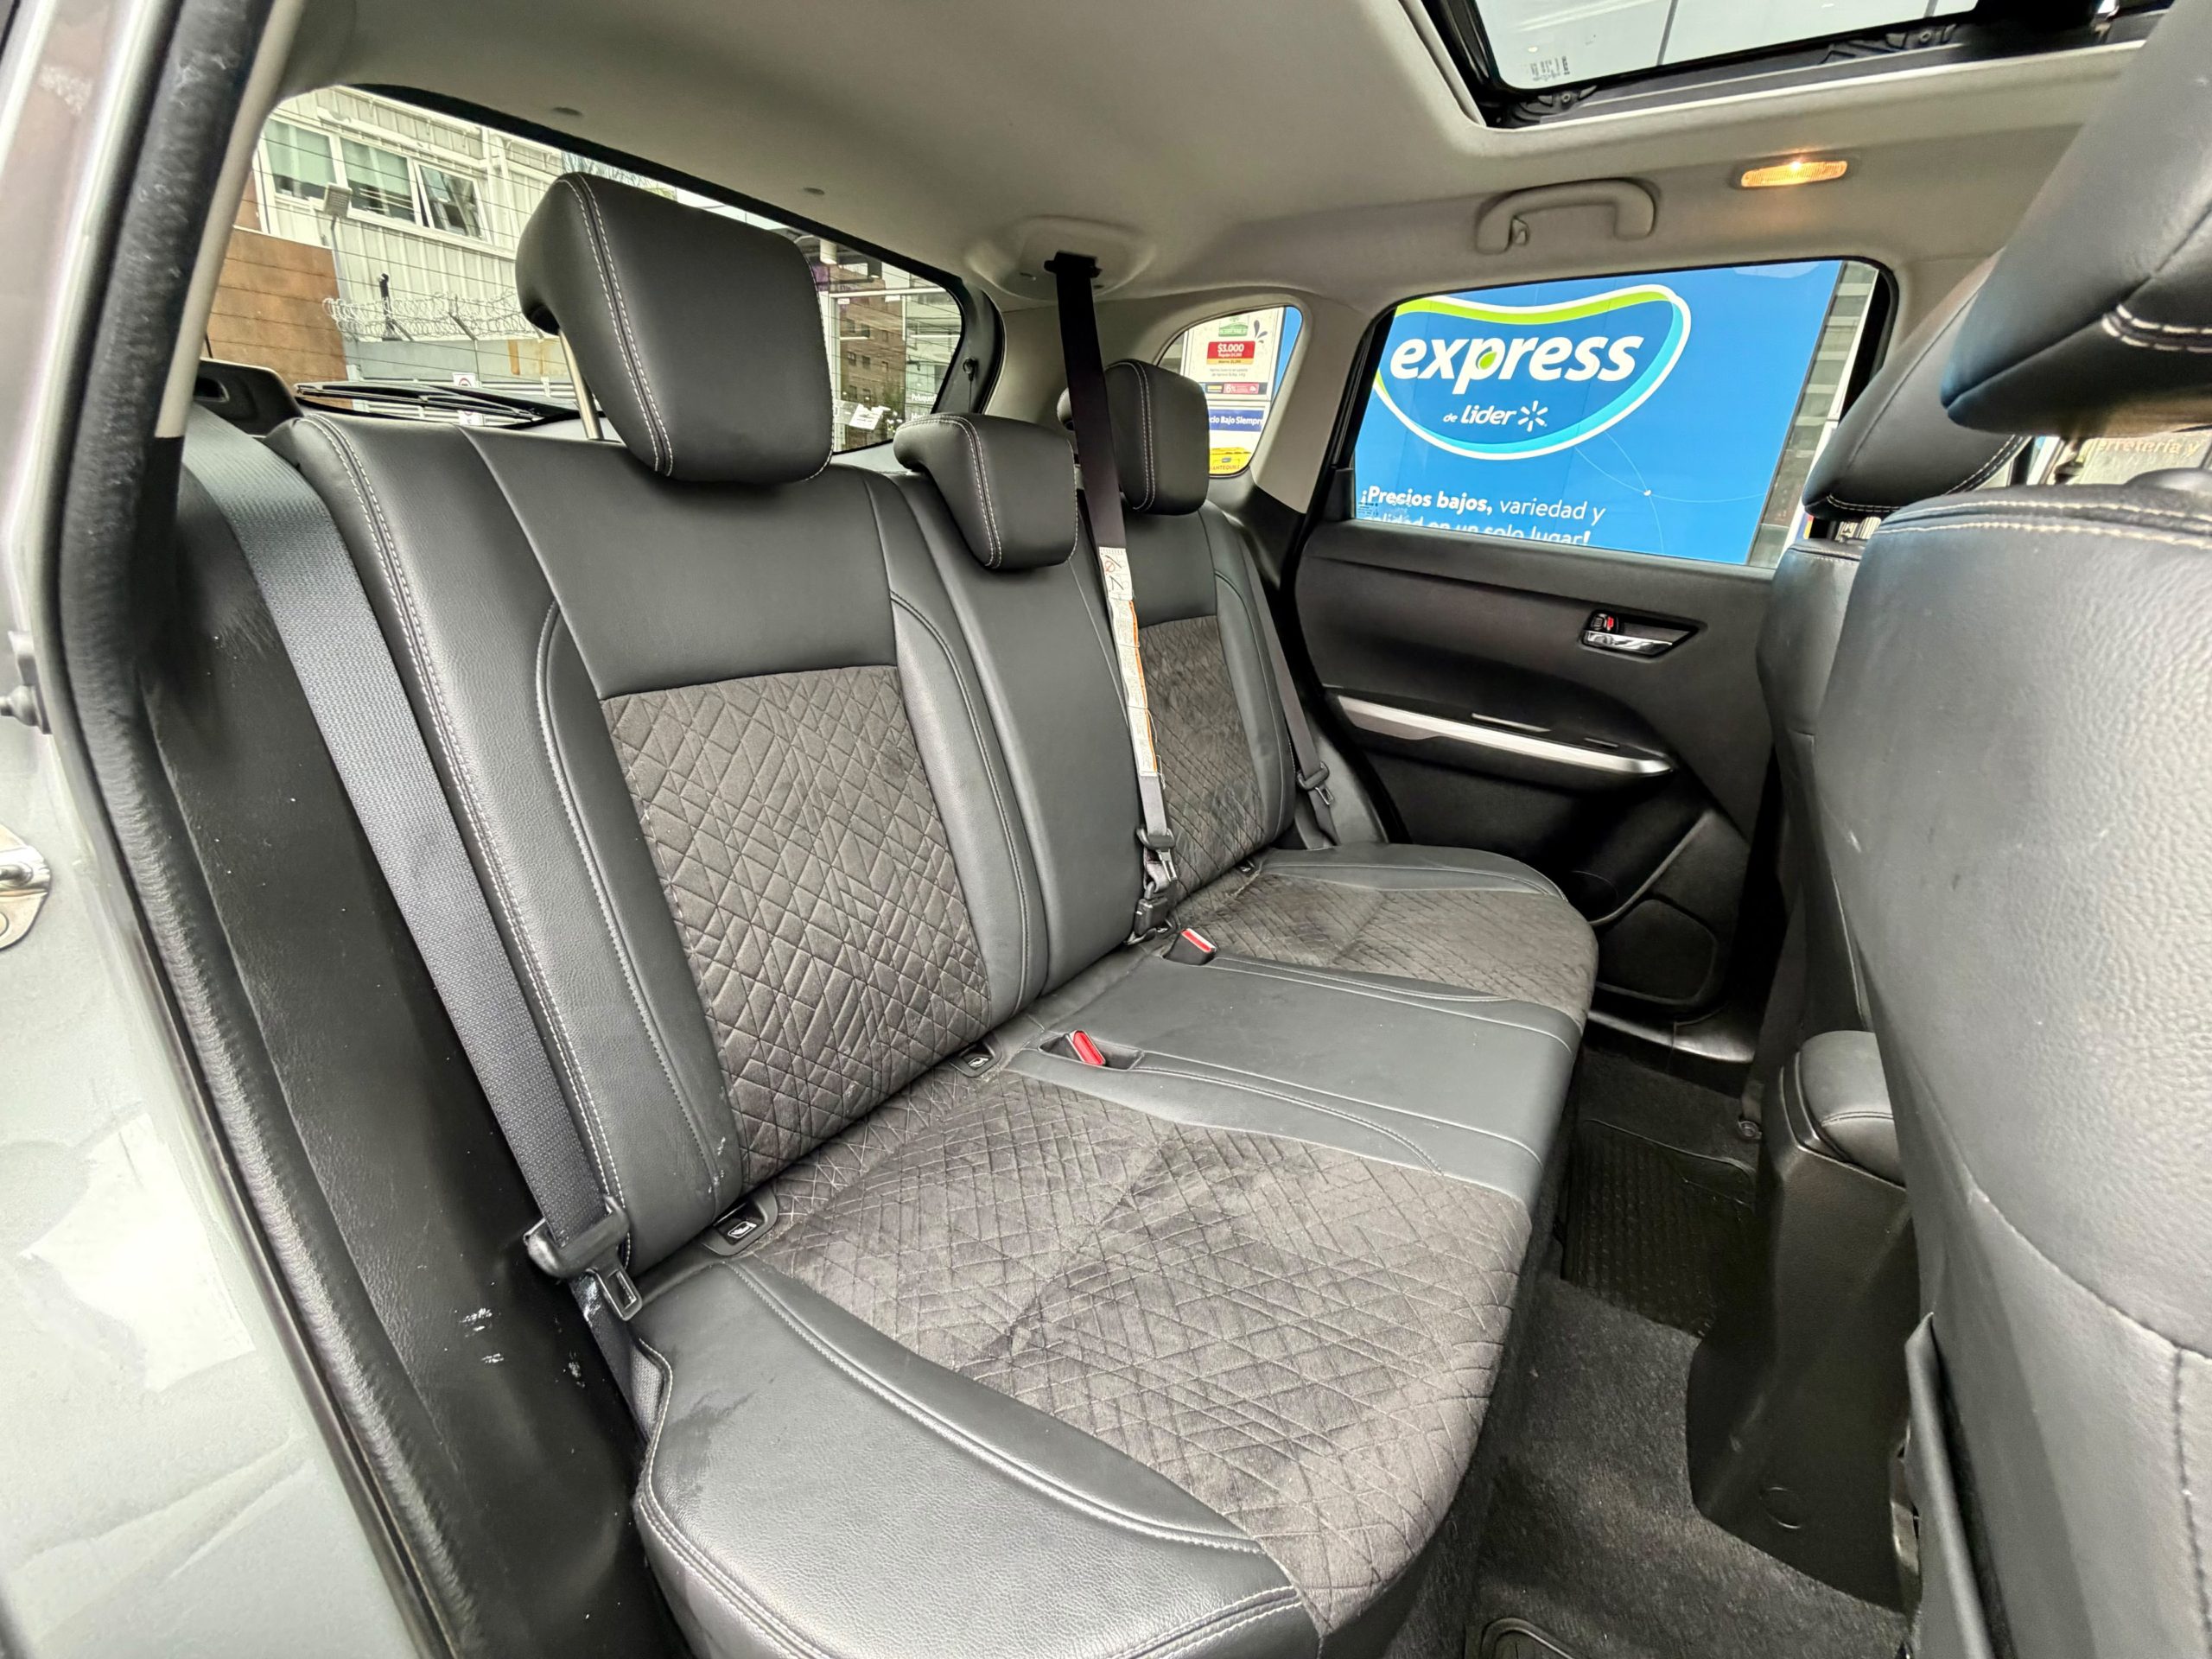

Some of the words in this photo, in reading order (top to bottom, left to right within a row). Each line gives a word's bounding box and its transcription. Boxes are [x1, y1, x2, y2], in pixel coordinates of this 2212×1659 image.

[1389, 335, 1644, 395] express
[1221, 416, 1236, 426] Bajo
[1236, 416, 1263, 427] Siempr
[1443, 413, 1458, 423] de
[1460, 404, 1516, 425] Lider
[2097, 438, 2181, 454] erretería
[1360, 485, 1432, 507] ¡Precios
[1436, 490, 1493, 516] bajos,
[1500, 497, 1588, 520] variedad
[1591, 506, 1606, 526] y
[1529, 525, 1592, 545] lugar!
